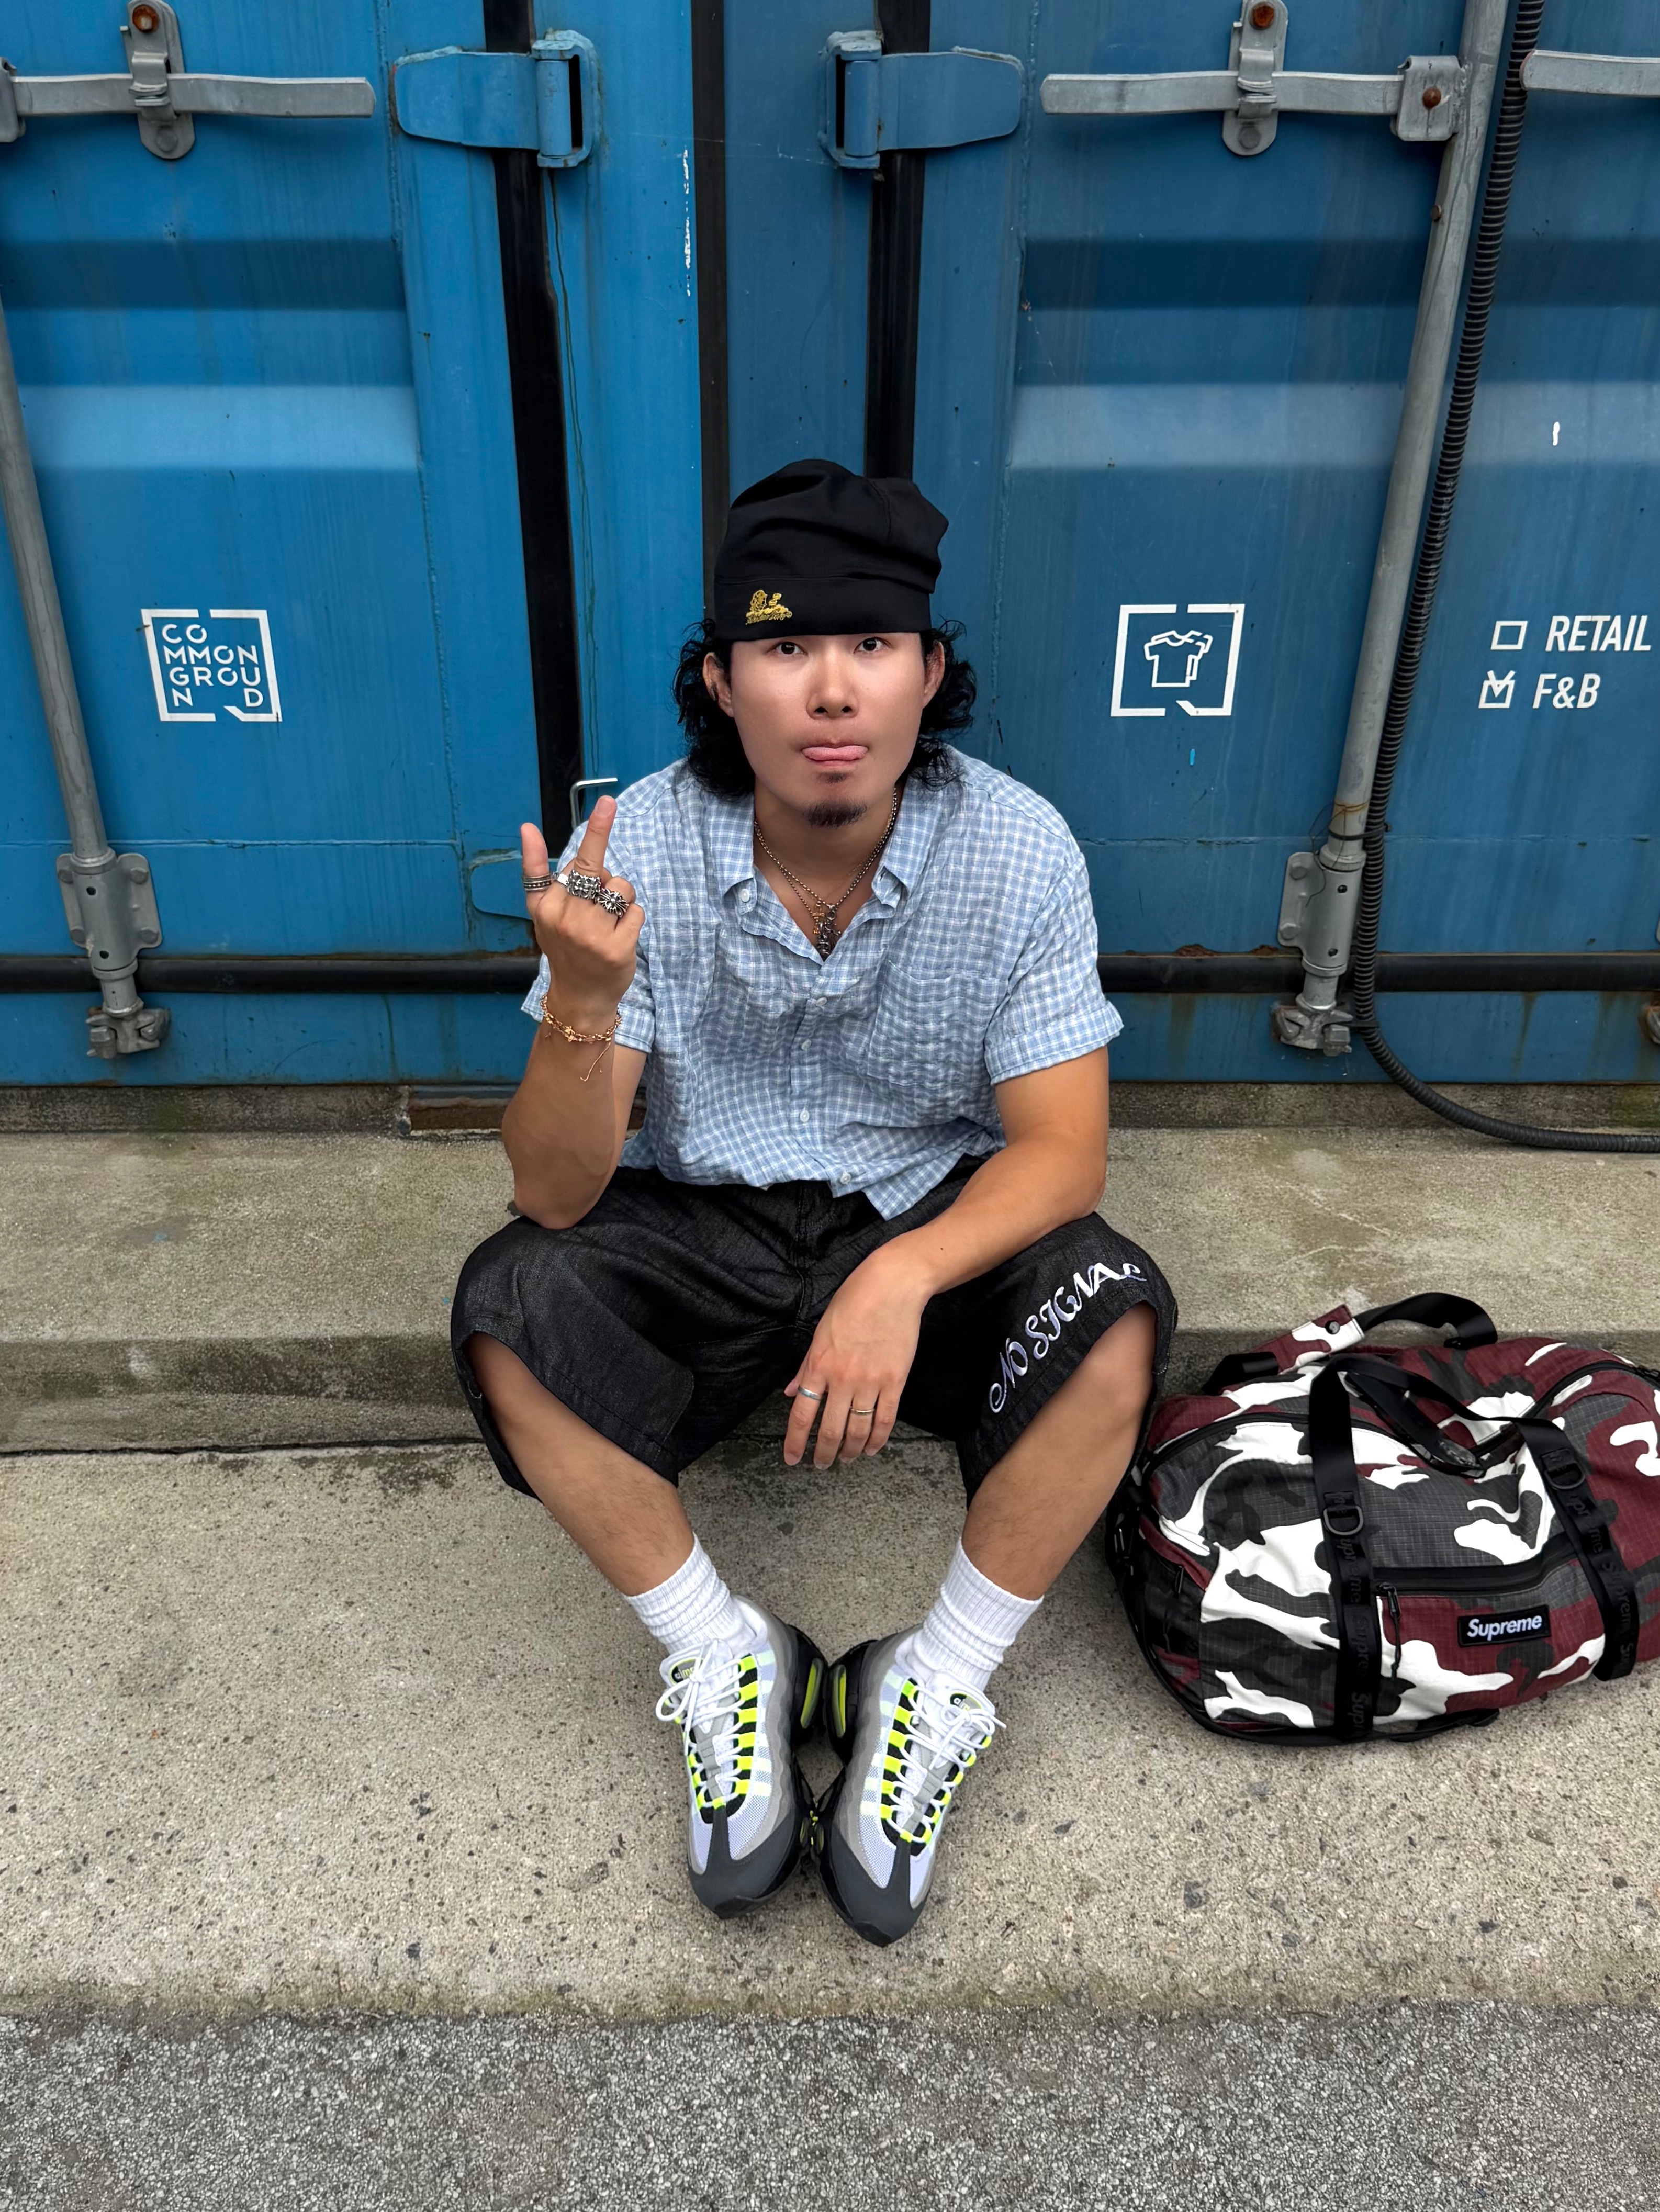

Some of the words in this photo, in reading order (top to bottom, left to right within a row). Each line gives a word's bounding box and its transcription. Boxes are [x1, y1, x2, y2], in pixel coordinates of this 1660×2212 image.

[162, 623, 208, 644] CO
[1545, 615, 1651, 652] RETAIL
[163, 645, 259, 665] MMON
[169, 666, 261, 686] GROU
[1532, 673, 1601, 709] F&B
[989, 1338, 1028, 1413] NO
[1025, 1262, 1147, 1360] SIGNAL
[1467, 1615, 1543, 1641] Supreme
